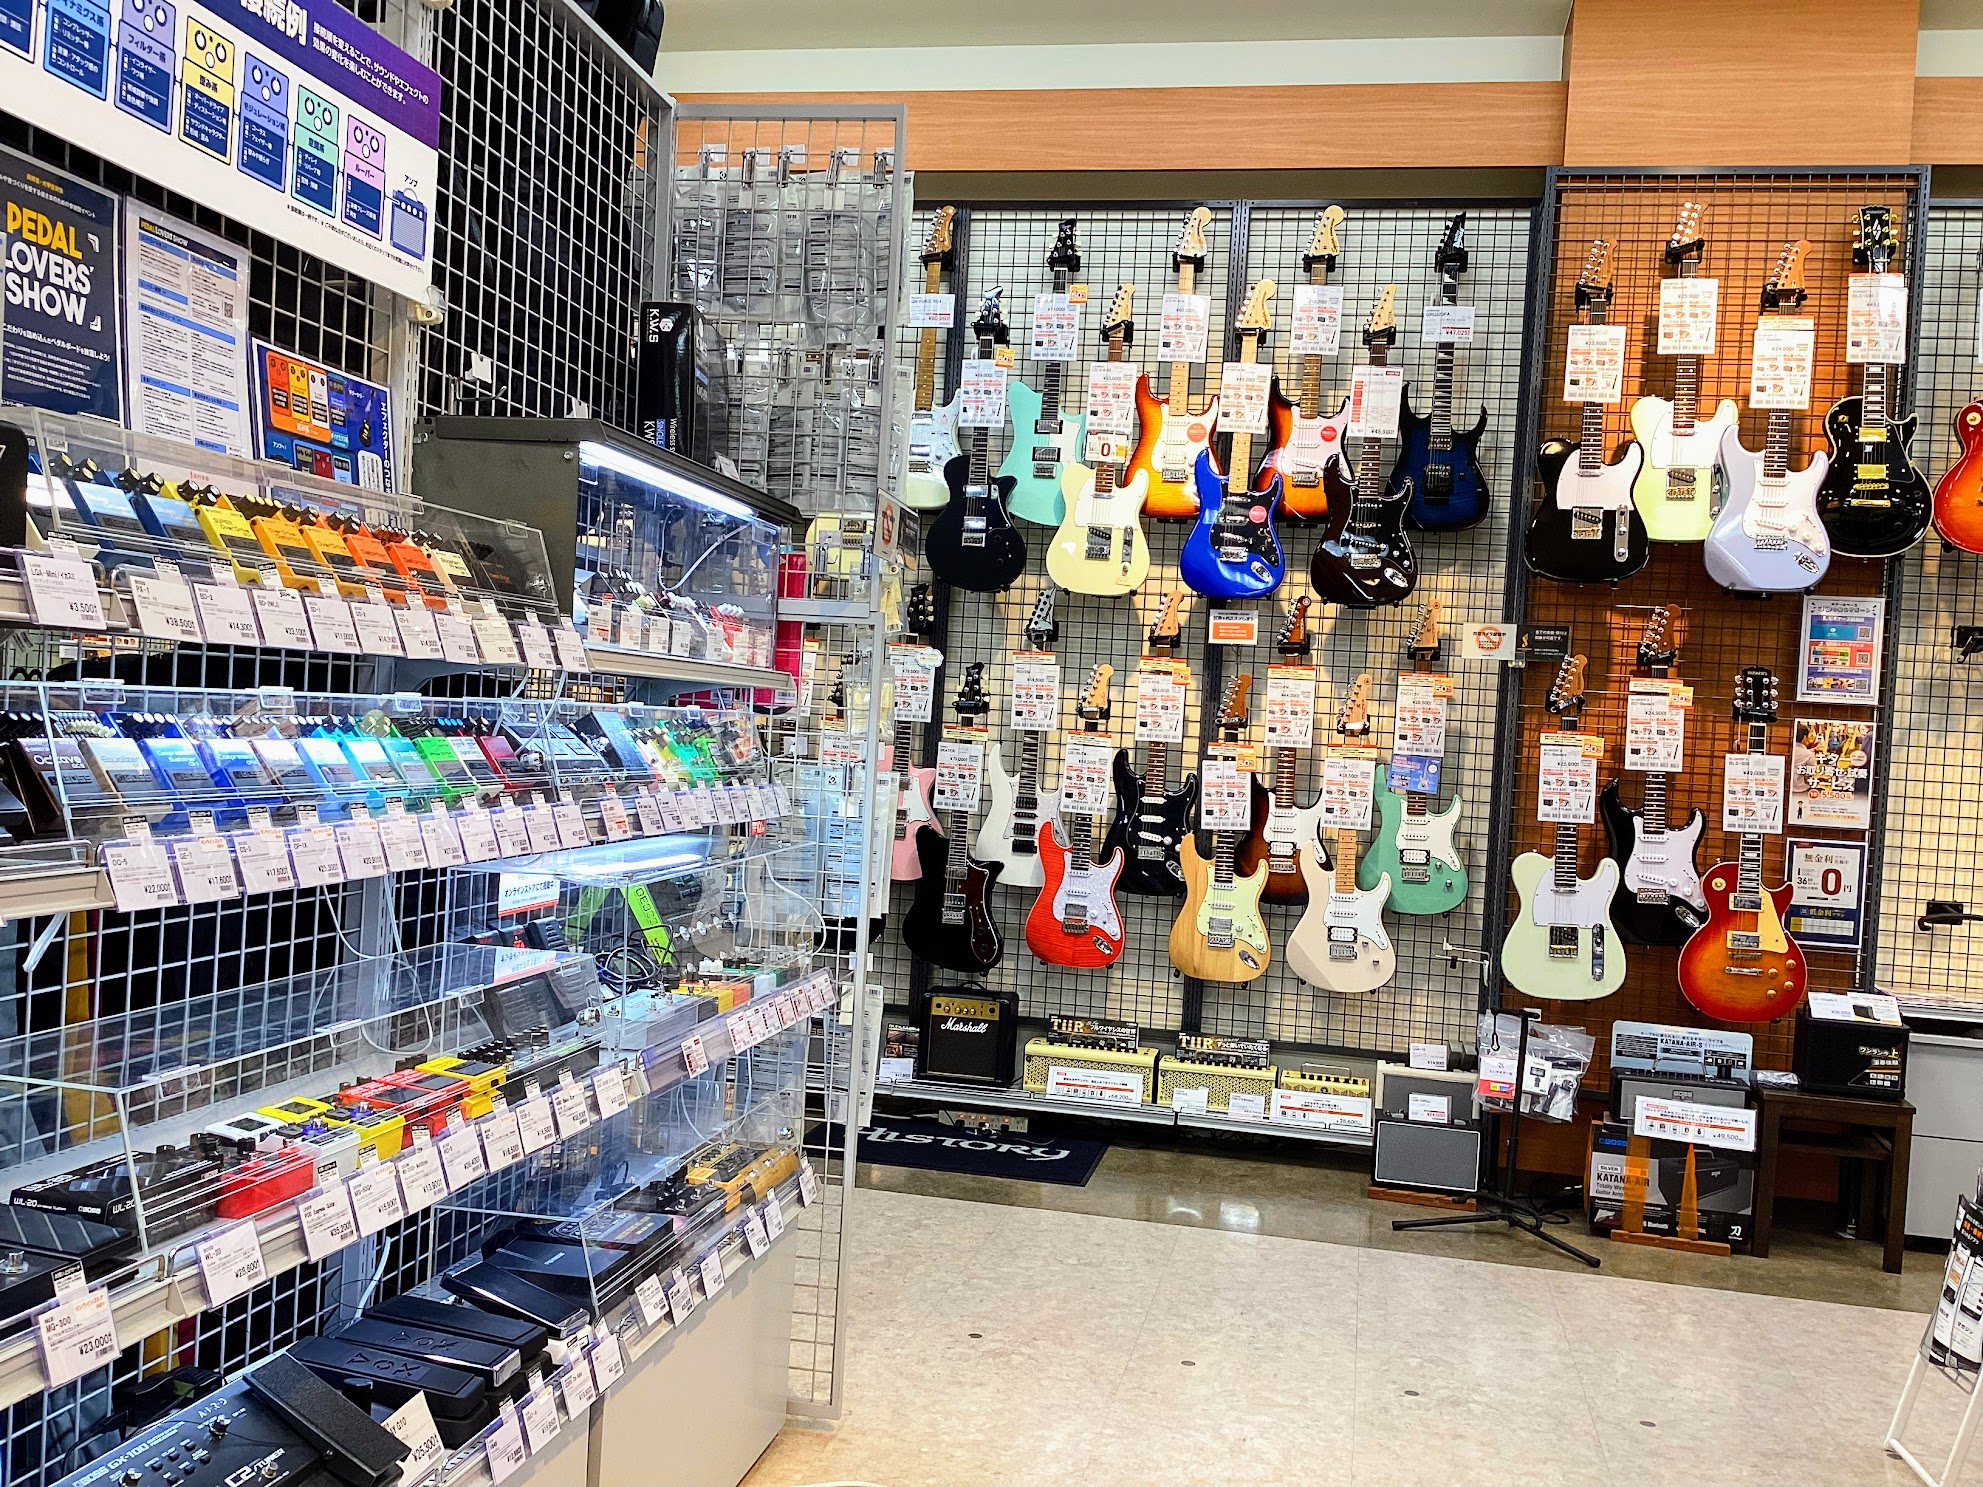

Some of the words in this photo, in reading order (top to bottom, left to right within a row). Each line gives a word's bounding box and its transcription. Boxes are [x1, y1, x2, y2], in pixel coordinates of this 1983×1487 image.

[7, 201, 83, 260] PEDAL
[5, 271, 87, 326] SHOW
[649, 308, 660, 343] K.W.S
[656, 420, 665, 447] SINGLE
[669, 417, 677, 446] Wireless
[316, 540, 347, 551] OverDrive
[1806, 776, 1855, 792] サービス
[1804, 853, 1834, 864] 無金利
[1796, 876, 1808, 885] 36
[1821, 868, 1842, 896] 0
[1843, 884, 1852, 893] 円
[1809, 908, 1832, 917] 低金利
[940, 1016, 989, 1034] Marshall
[1712, 1133, 1740, 1142] ¥49,500
[1596, 1172, 1650, 1187] KATANA-AIR
[13, 1197, 38, 1208] WL-20
[1730, 1225, 1742, 1237] 刀
[46, 1316, 72, 1334] MG-300
[79, 1334, 110, 1356] ¥23,000
[107, 1442, 150, 1470] GX-100
